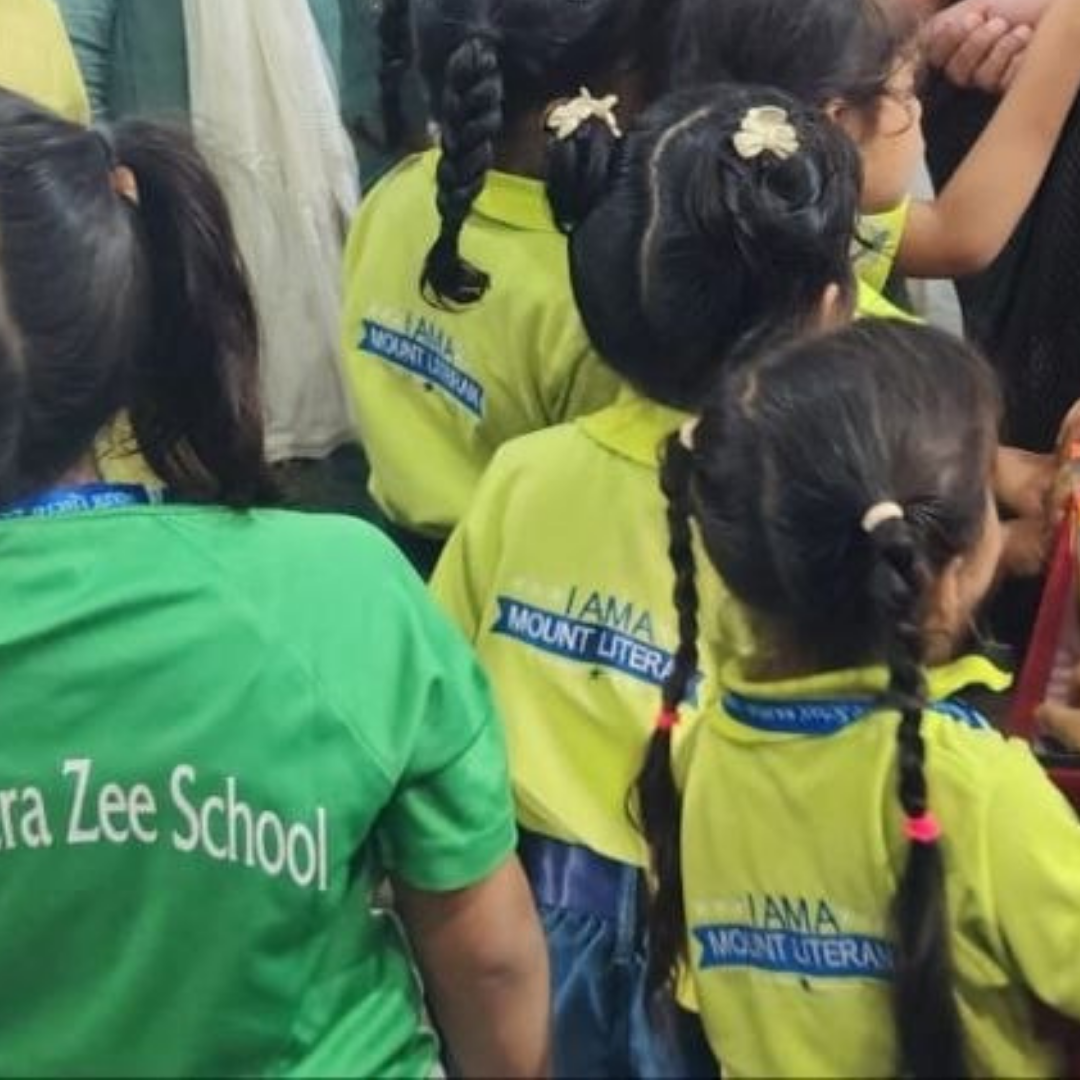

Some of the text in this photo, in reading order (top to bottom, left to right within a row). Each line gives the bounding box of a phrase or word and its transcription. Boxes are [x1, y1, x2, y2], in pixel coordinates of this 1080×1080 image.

[507, 604, 676, 681] MOUNT LITERA
[0, 758, 328, 891] ra Zee School
[707, 929, 789, 964] MOUNT
